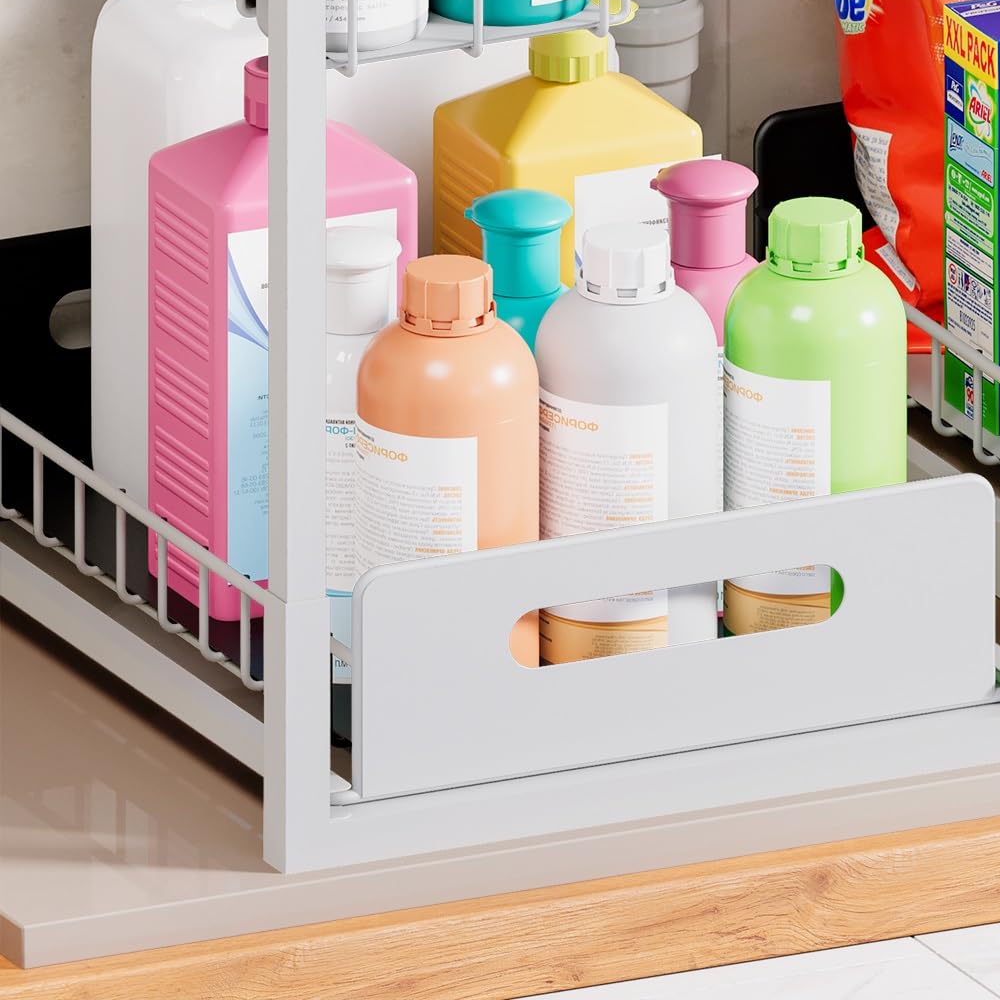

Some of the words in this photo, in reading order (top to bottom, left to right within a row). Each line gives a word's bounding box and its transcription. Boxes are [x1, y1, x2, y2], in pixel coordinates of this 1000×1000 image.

[946, 15, 966, 58] XXL
[967, 31, 996, 79] PACK
[969, 96, 992, 123] ARIEL
